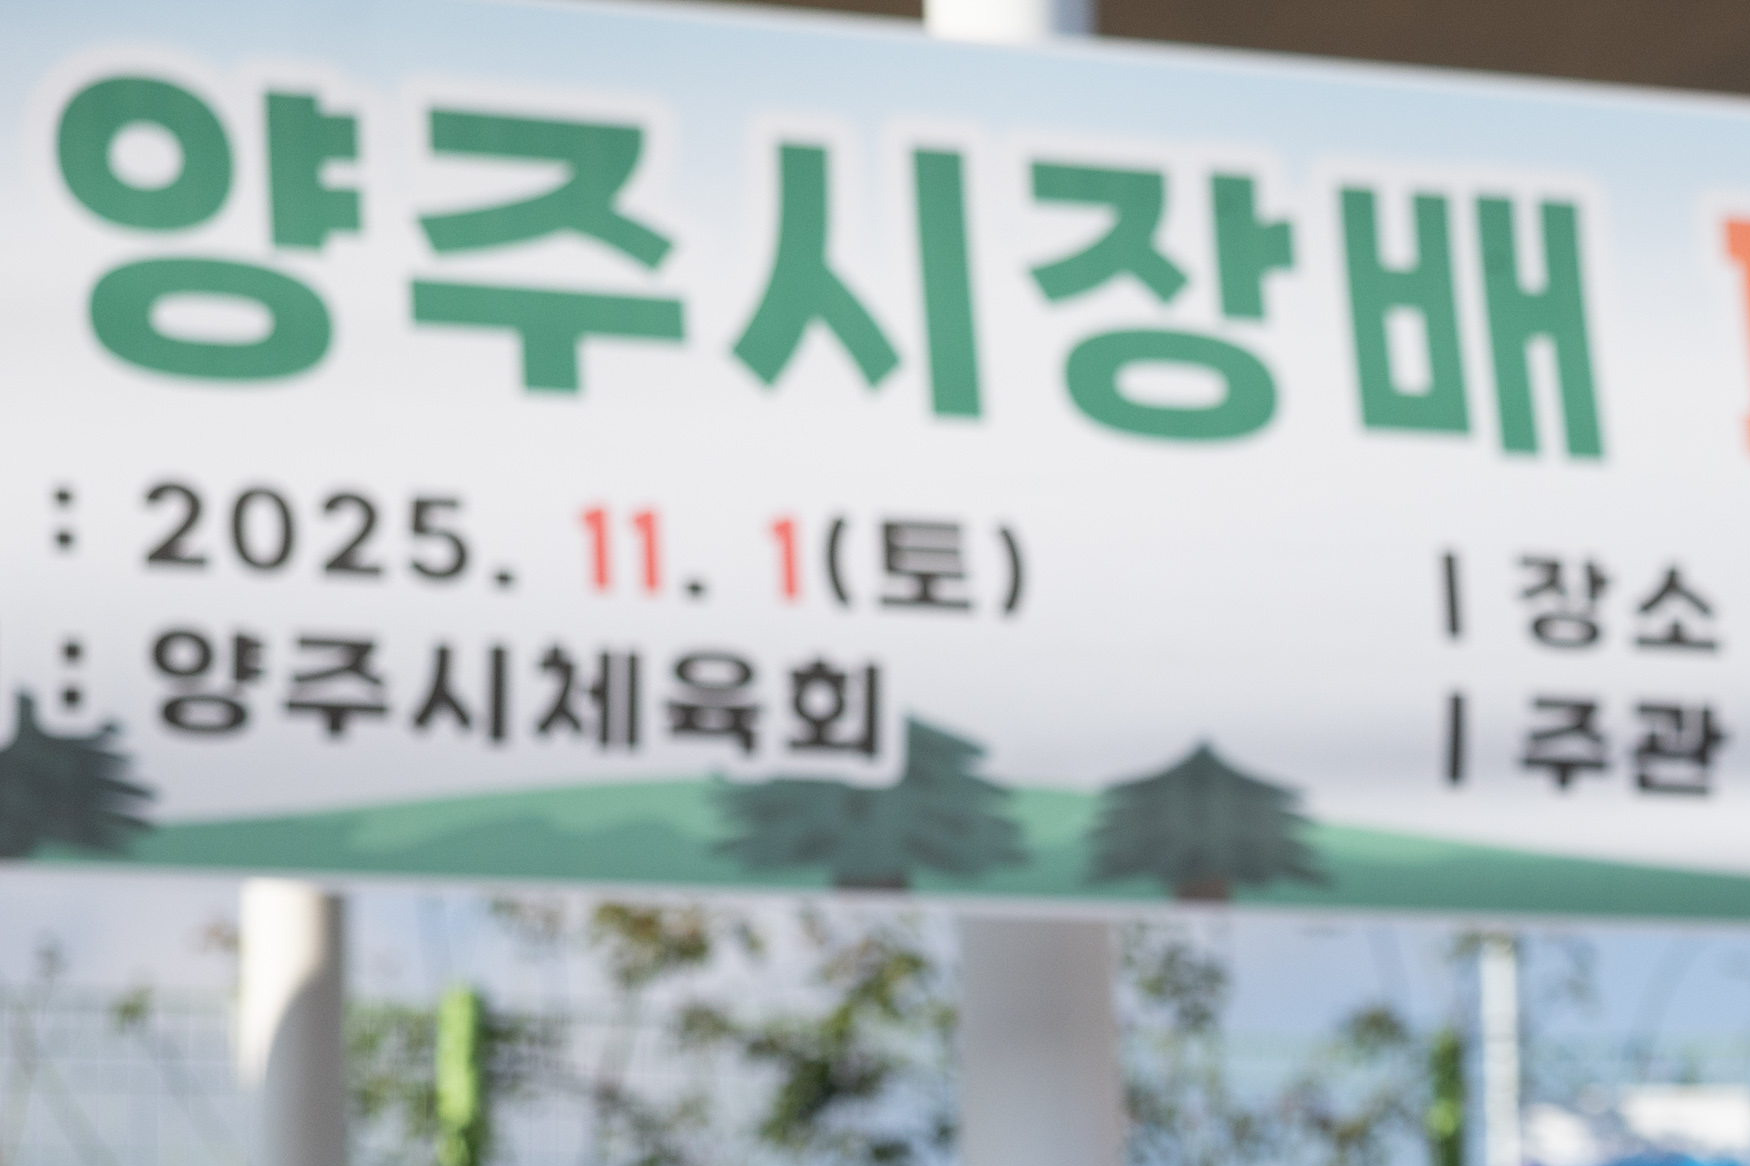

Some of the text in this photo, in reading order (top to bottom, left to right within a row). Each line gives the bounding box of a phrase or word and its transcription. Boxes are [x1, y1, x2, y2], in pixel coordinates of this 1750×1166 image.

[54, 73, 1608, 462] 양주시장배
[143, 480, 516, 588] 2025.
[581, 505, 706, 599] 11.
[1518, 554, 1720, 654] 장소
[148, 626, 884, 760] 양주시체육회
[1516, 693, 1732, 800] 주관
